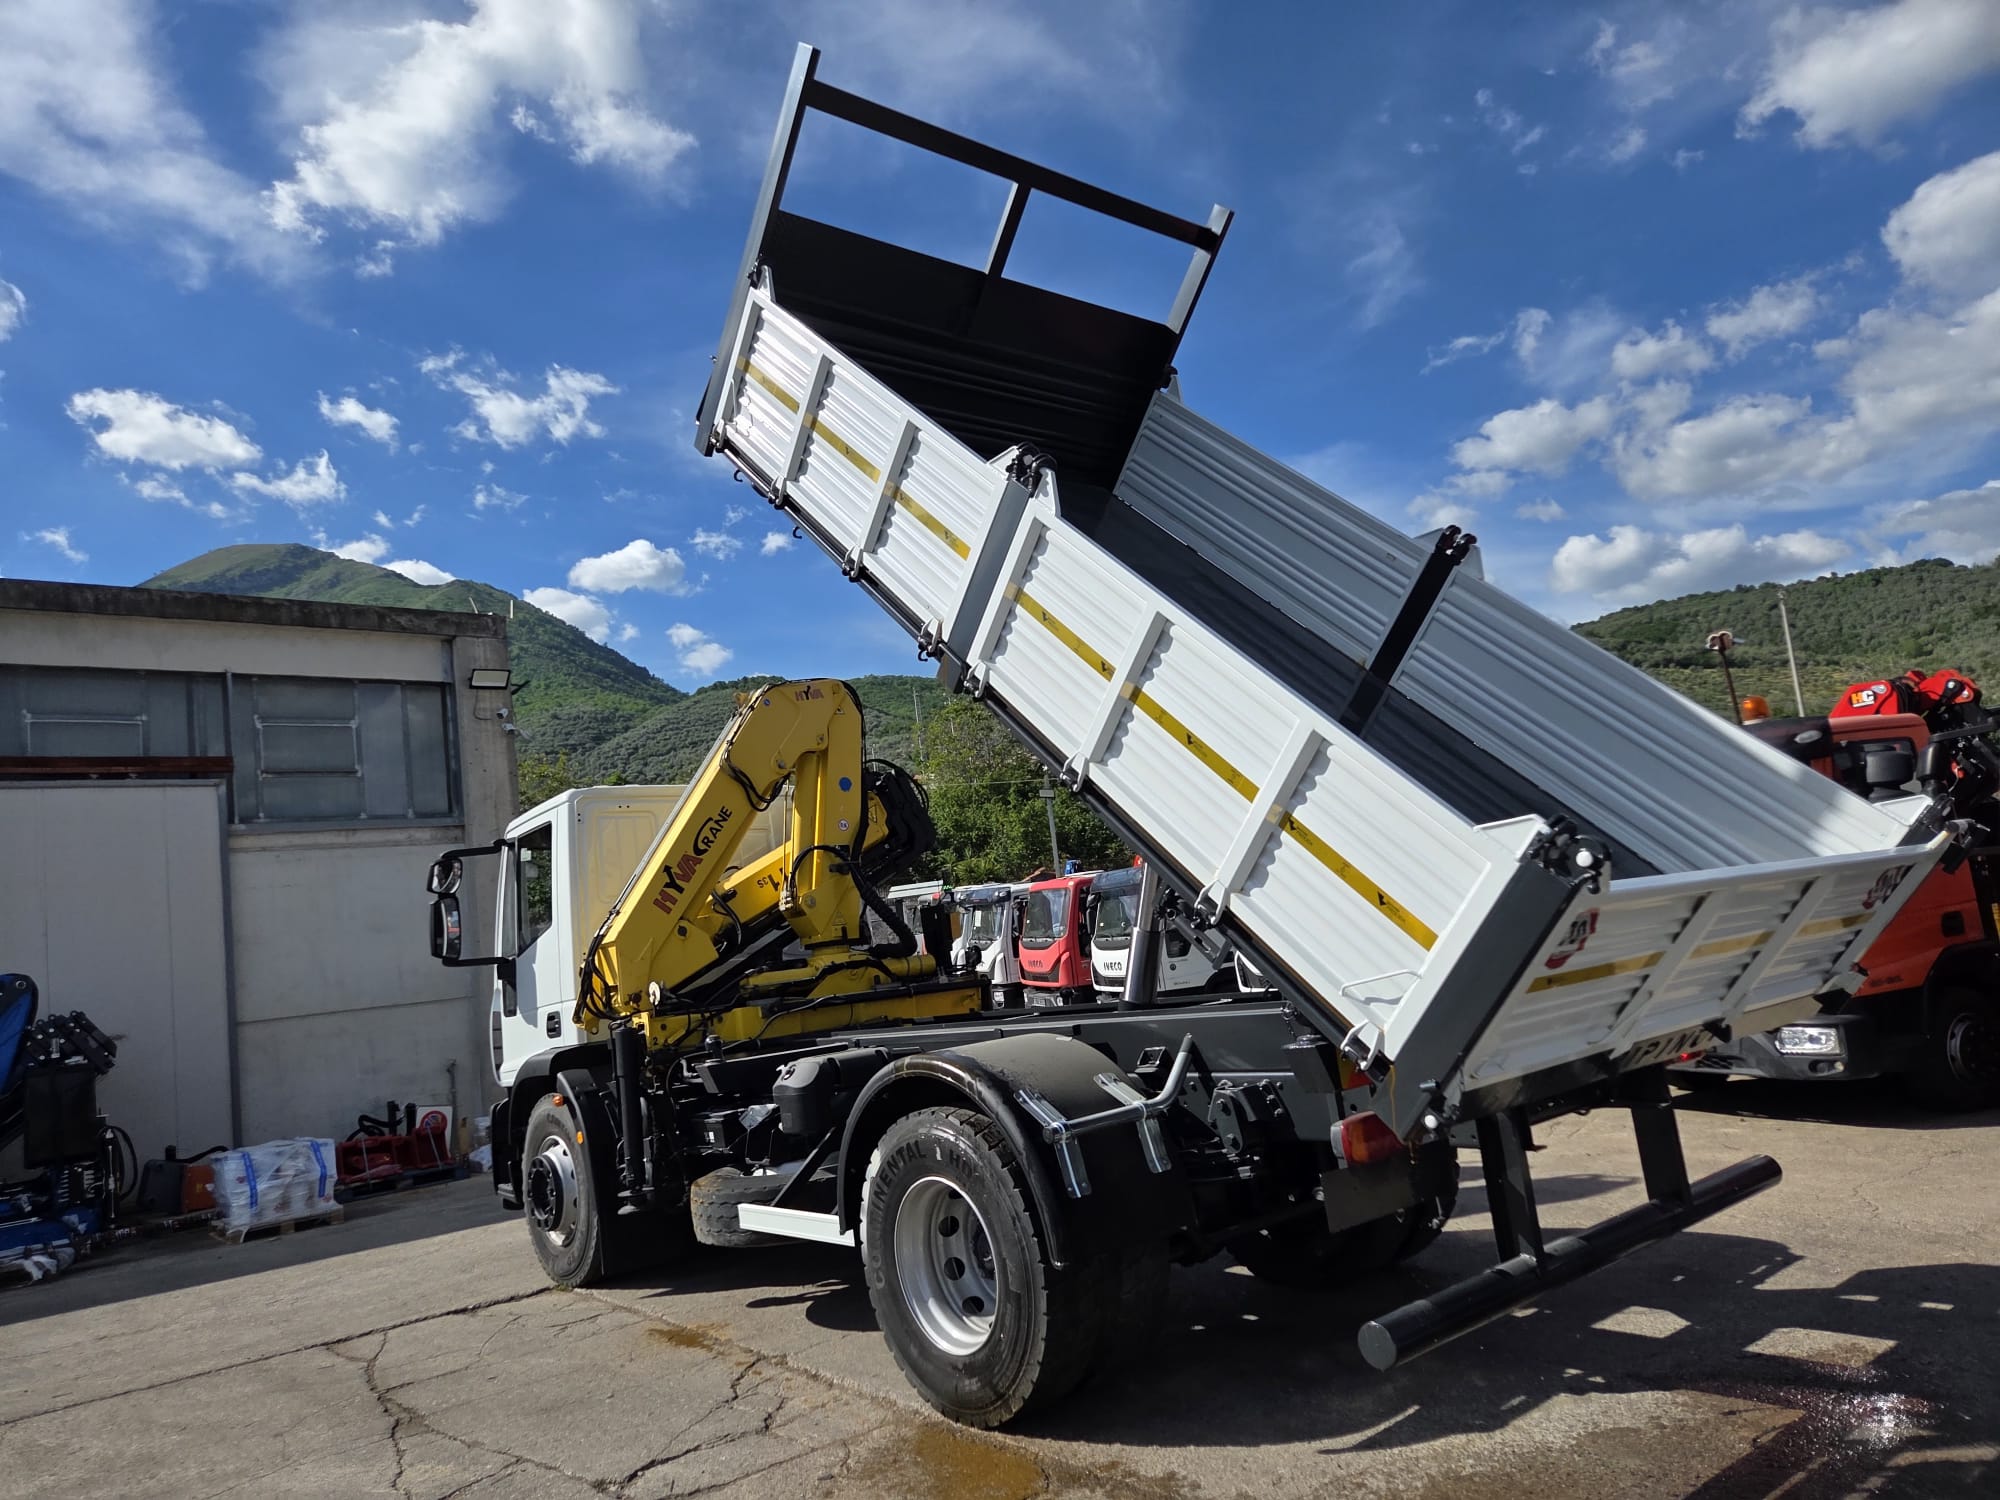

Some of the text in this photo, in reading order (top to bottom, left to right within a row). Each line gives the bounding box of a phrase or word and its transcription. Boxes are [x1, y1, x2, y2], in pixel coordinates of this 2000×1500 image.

[795, 685, 824, 702] HYVA
[1851, 690, 1875, 704] HC
[653, 806, 733, 915] HYVA CRANE
[1027, 960, 1044, 969] IVECO
[1103, 961, 1123, 972] IVECO
